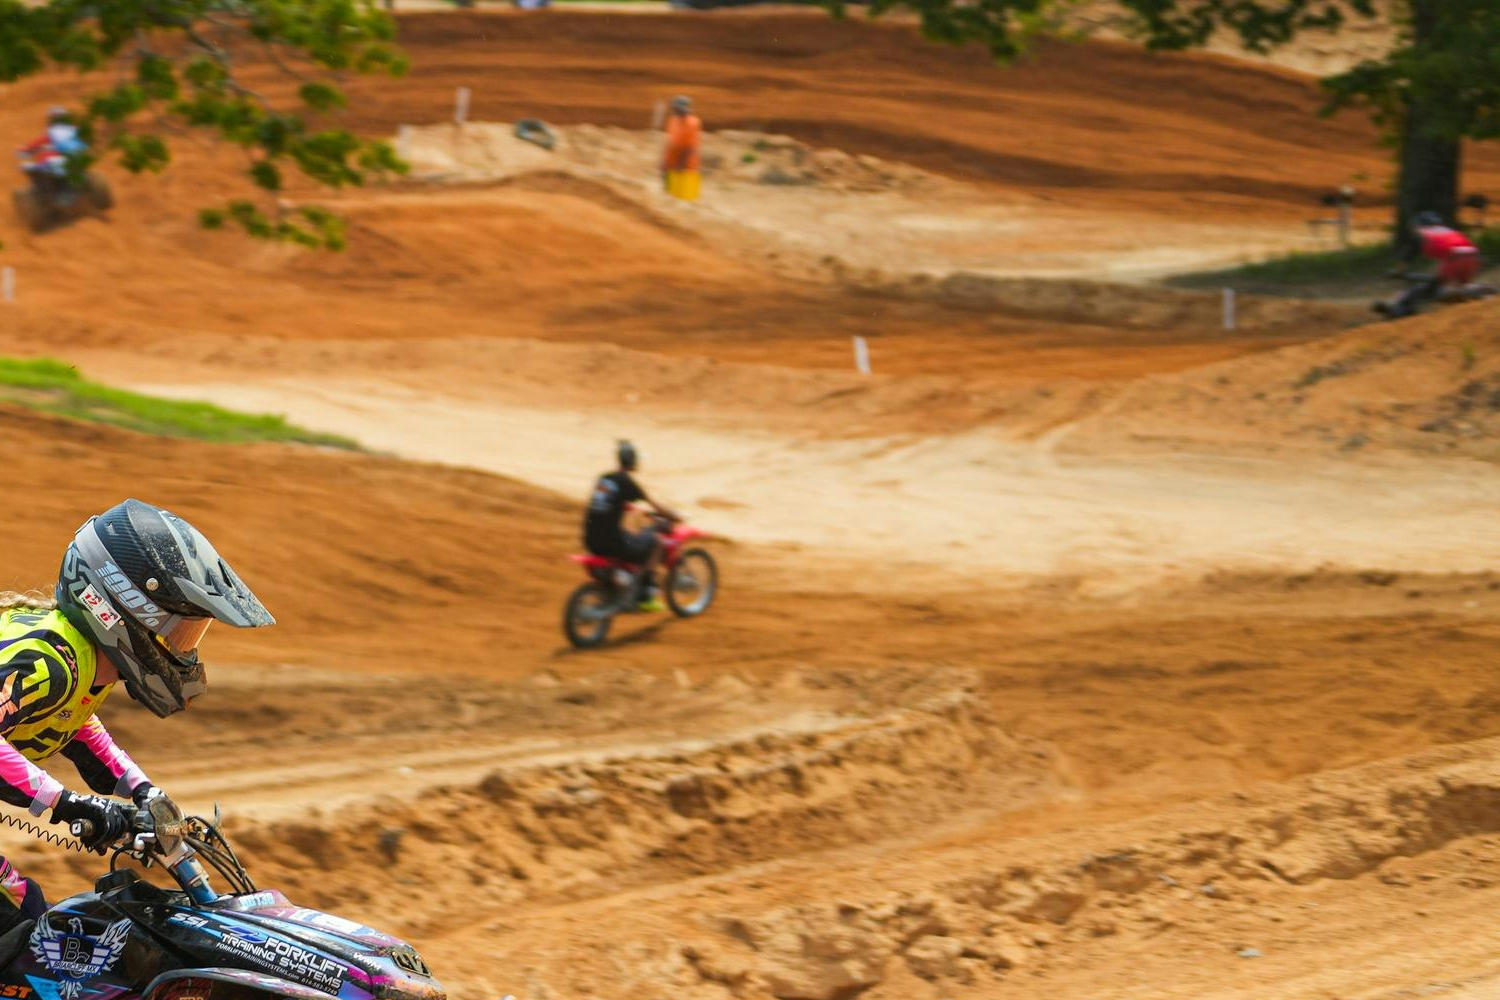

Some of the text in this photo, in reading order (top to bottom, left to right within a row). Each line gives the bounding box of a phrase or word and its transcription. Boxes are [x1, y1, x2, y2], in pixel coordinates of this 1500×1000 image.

[220, 932, 275, 961] TRAINING
[279, 957, 342, 989] SYSTEMS
[264, 936, 348, 978] FORKLIFT
